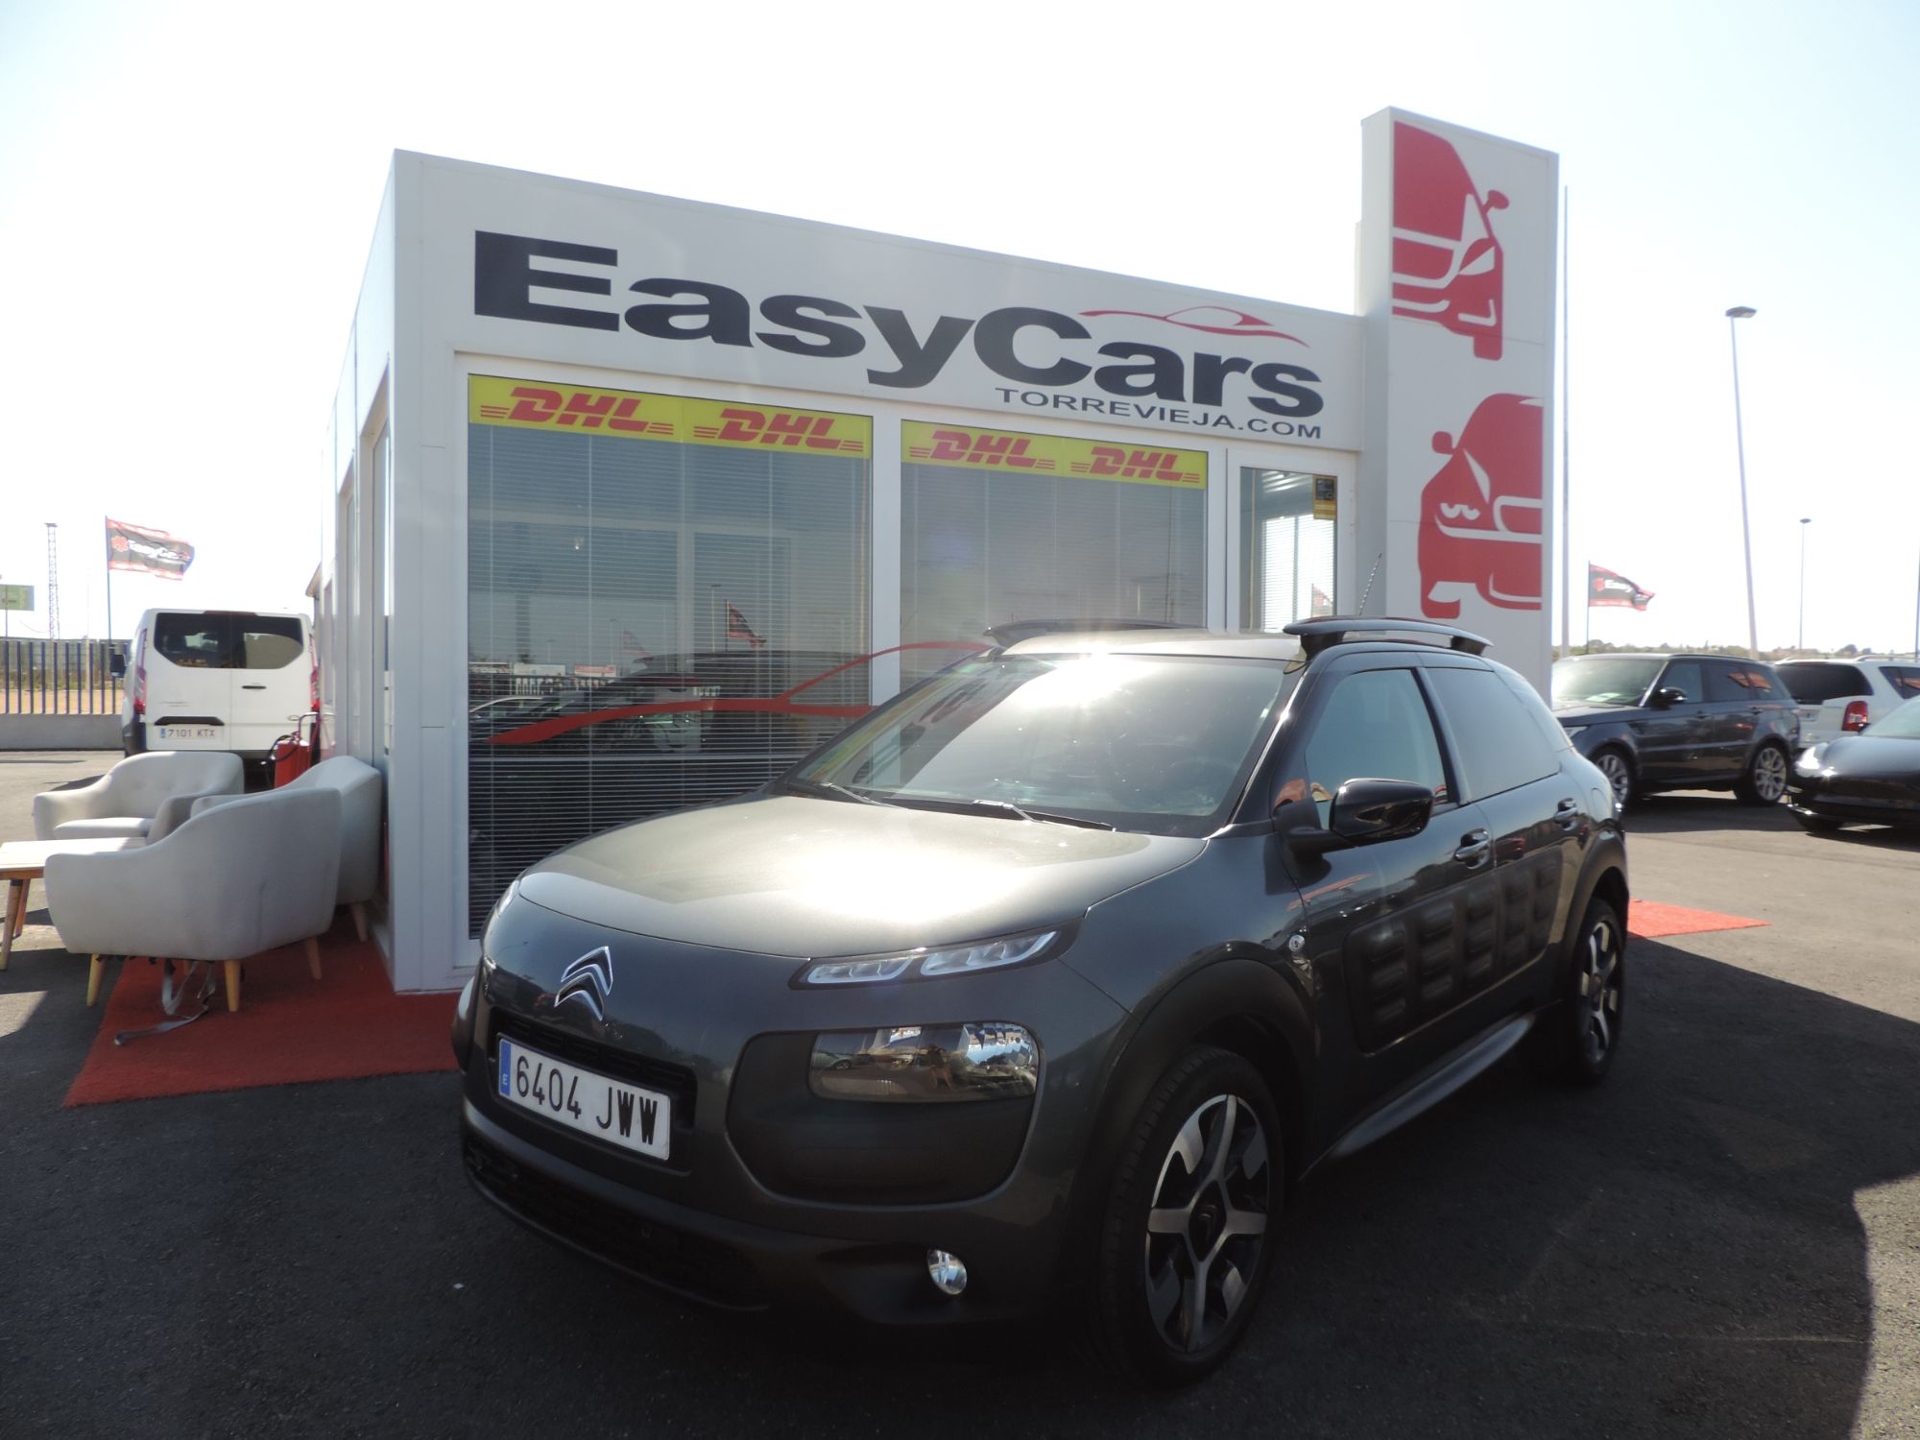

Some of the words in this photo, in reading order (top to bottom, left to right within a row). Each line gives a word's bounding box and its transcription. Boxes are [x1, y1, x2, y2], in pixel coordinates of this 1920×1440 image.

[475, 230, 1324, 418] EasyCars
[507, 386, 649, 432] DHL
[717, 408, 842, 451] DHL
[994, 387, 1321, 440] TORREVIEJA.COM
[929, 430, 1038, 468] DHL
[1088, 447, 1184, 481] DHL
[167, 728, 192, 738] 7101
[196, 728, 216, 738] KTX
[516, 1055, 582, 1120] 6404
[596, 1086, 658, 1146] JWW
